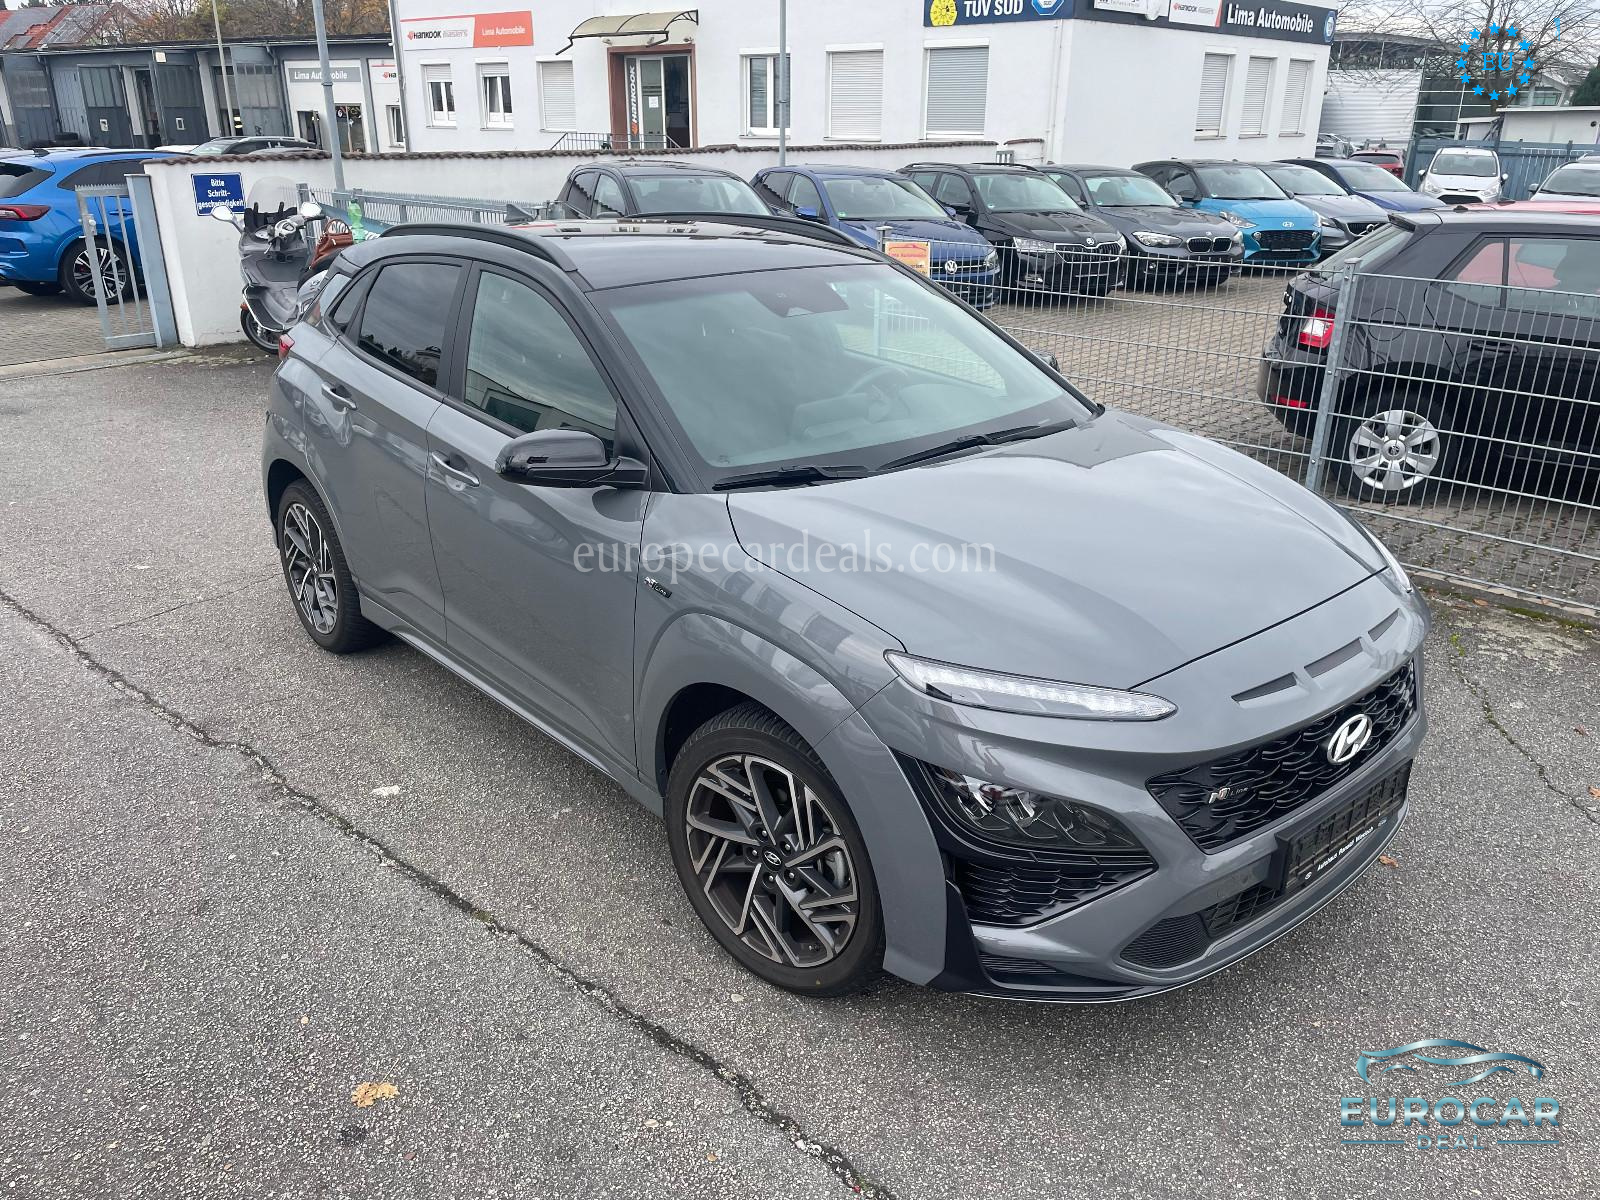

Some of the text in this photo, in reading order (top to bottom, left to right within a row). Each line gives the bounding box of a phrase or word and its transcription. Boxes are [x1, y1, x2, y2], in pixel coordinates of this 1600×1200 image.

[1226, 3, 1255, 26] Lima
[1256, 8, 1314, 33] Automobile
[482, 25, 526, 36] Lima Automobile
[294, 71, 309, 80] Lima
[210, 178, 225, 186] Bitte
[207, 189, 231, 197] Schritt-
